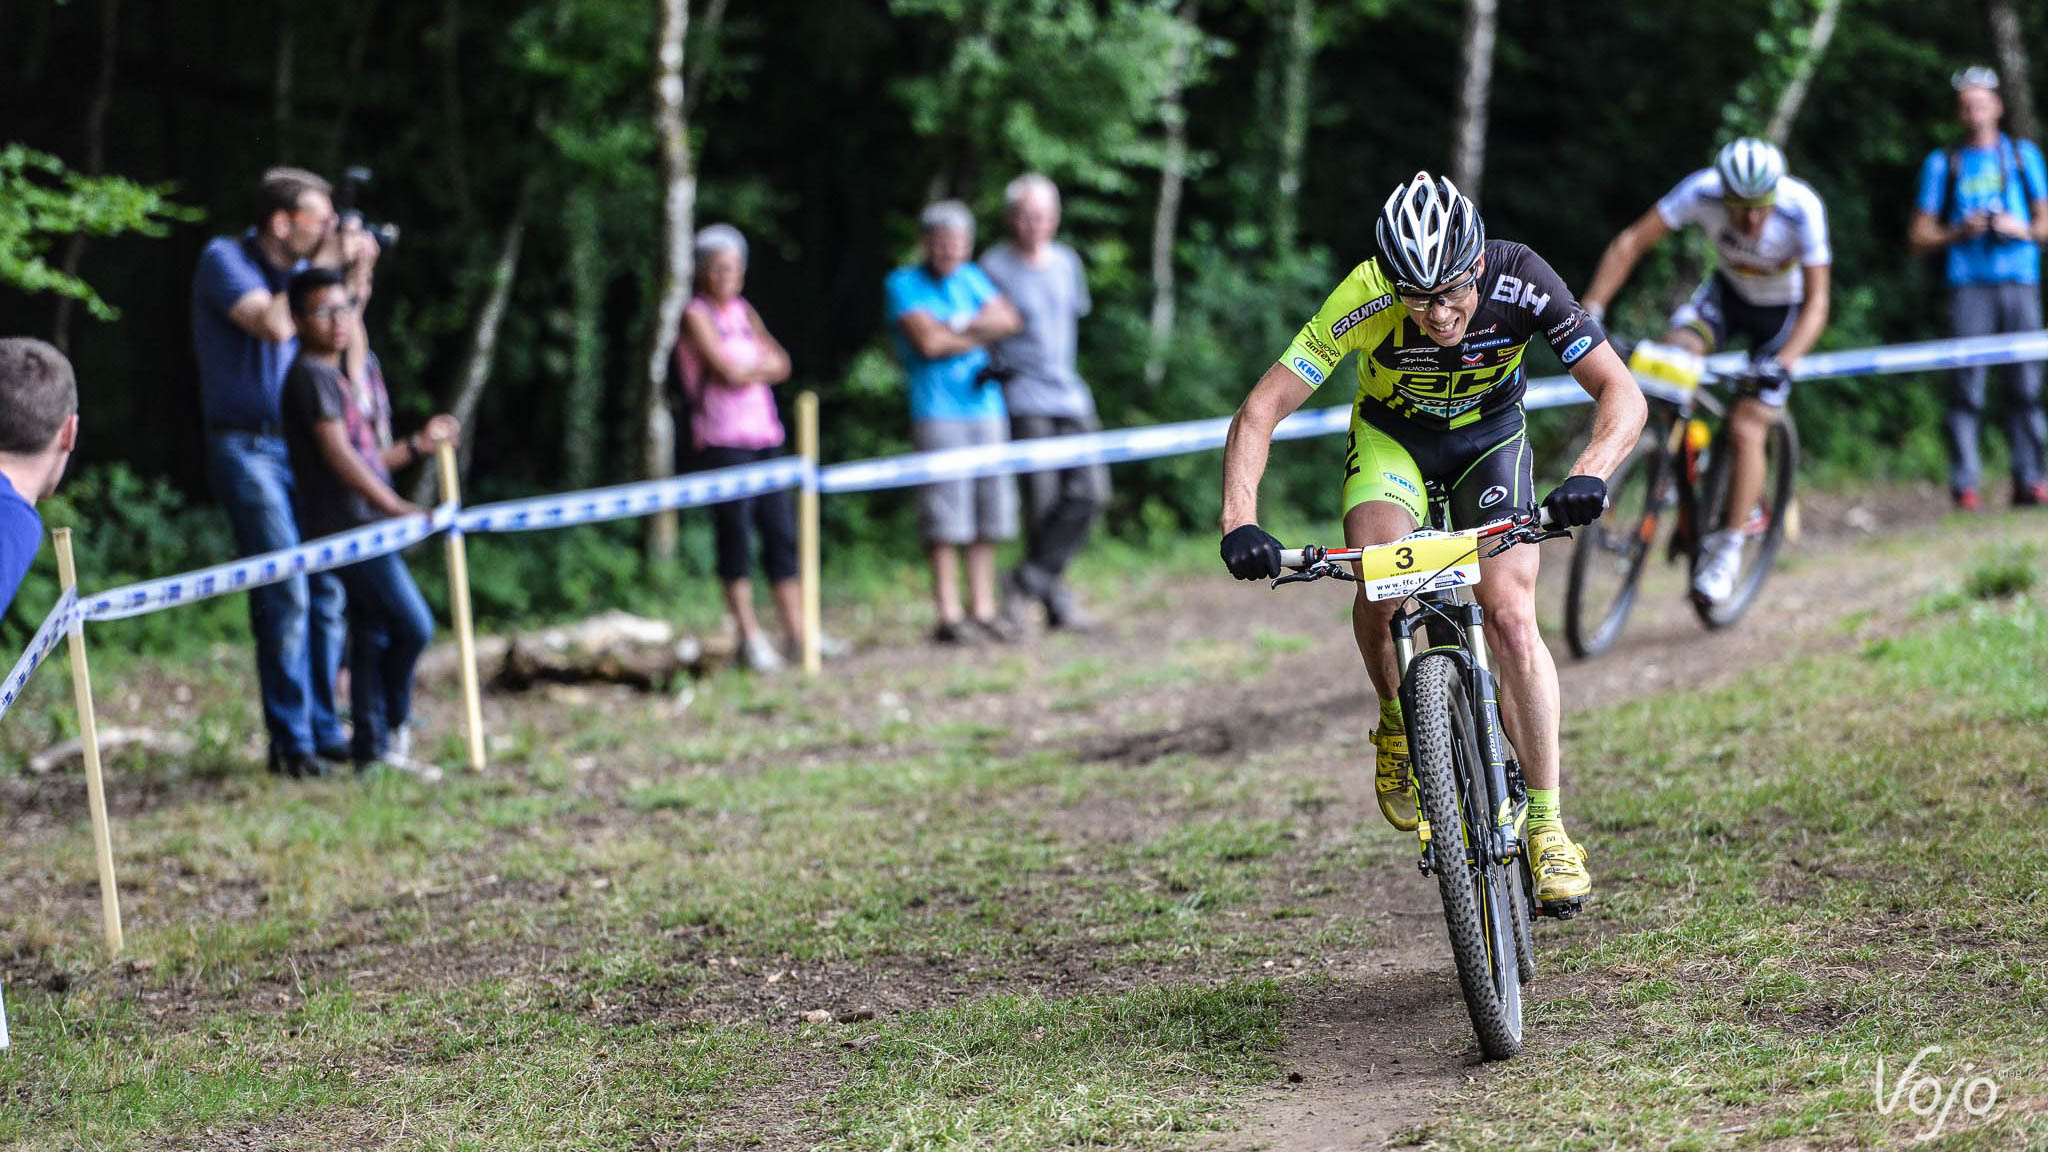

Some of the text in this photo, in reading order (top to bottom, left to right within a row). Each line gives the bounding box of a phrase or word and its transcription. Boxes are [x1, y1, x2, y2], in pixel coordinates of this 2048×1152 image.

[1490, 274, 1551, 316] BH
[1471, 338, 1511, 349] MICHELIN
[1564, 339, 1589, 362] KMC
[1297, 361, 1322, 382] KMC
[1398, 366, 1506, 394] BH
[1395, 547, 1414, 569] 3
